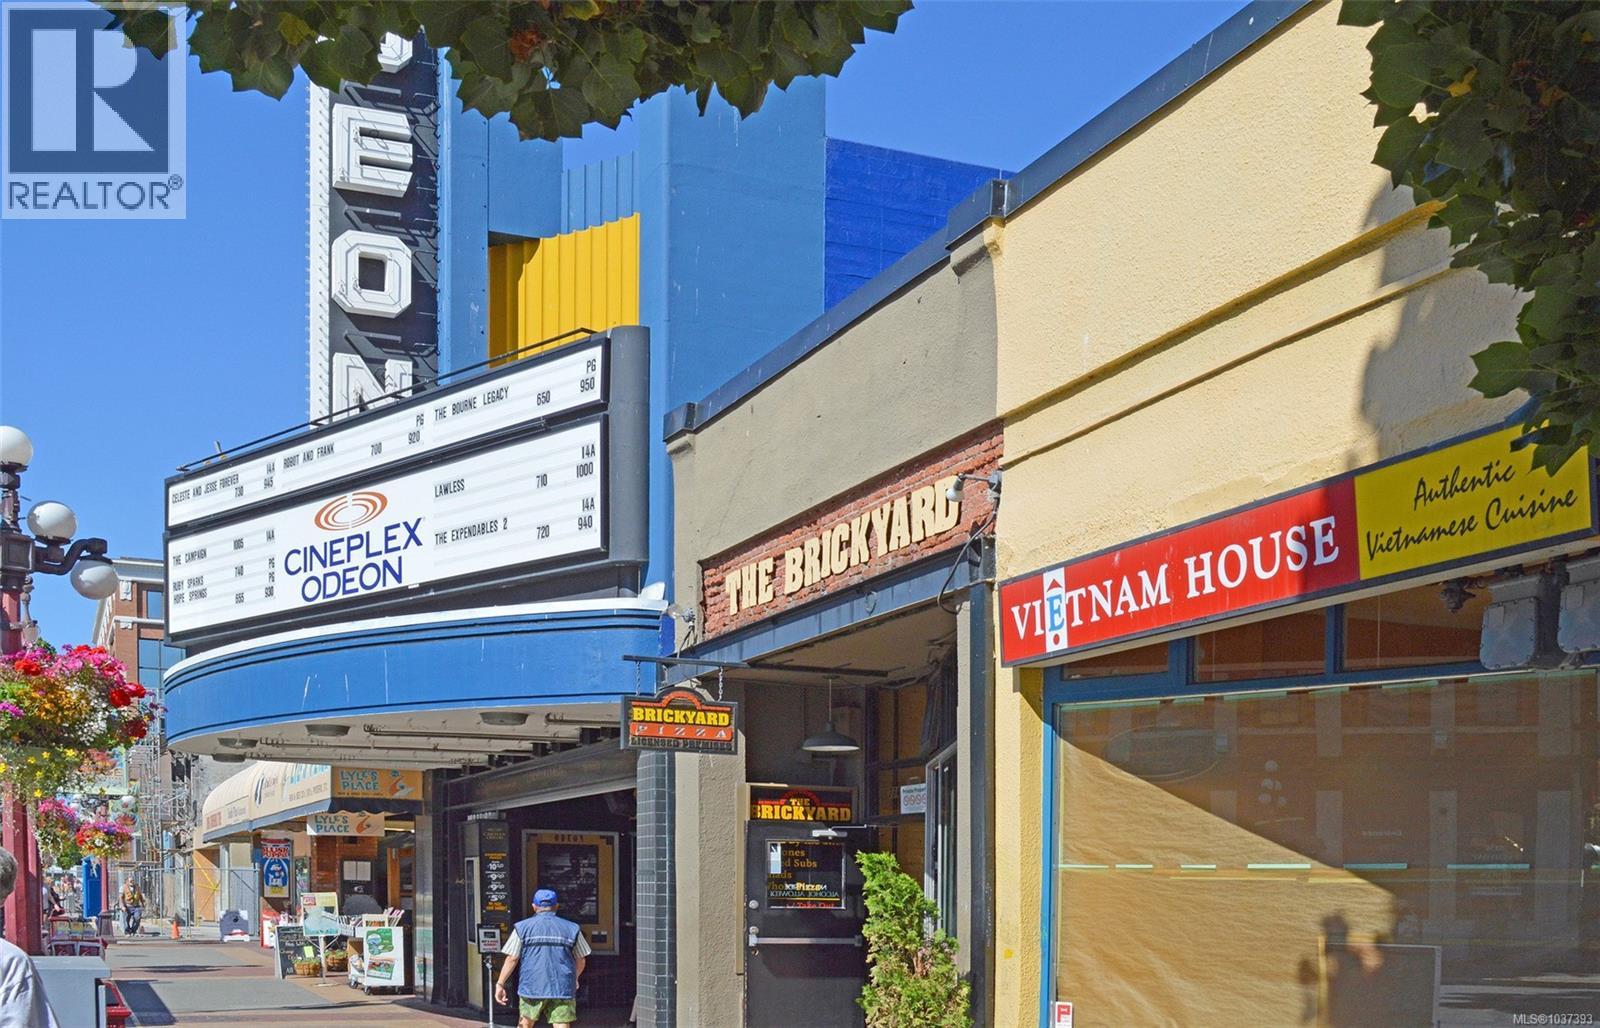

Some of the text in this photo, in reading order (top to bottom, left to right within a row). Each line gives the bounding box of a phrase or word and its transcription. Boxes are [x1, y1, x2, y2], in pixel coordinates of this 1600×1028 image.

[434, 358, 597, 421] THE BOURNE LEGACY PG
[536, 377, 595, 406] 650 950
[283, 413, 425, 469] ROBOT AND FRANK PG
[371, 430, 421, 457] 700 920
[434, 443, 596, 498] LAWLESS 14A
[536, 461, 594, 489] 710 1000
[172, 489, 190, 504] CELESTE
[192, 486, 202, 497] AND
[204, 480, 218, 495] JESSE
[219, 473, 239, 488] FOREVER
[1414, 459, 1516, 511] Authentic
[434, 497, 595, 545] THE EXPENDABLES 2 14A
[536, 515, 593, 540] 720 940
[1366, 489, 1578, 561] Vietnamese Cuisine
[173, 554, 182, 567] THE
[184, 547, 207, 564] CAMPAIGN
[284, 517, 423, 576] CINEPLEX
[725, 475, 962, 616] THE BRICKYARD
[1184, 515, 1340, 600] HOUSE
[187, 575, 204, 589] SPARKS
[301, 556, 403, 602] ODEON
[188, 587, 207, 602] SPRINGS
[632, 707, 730, 726] BRICKYARD
[630, 737, 680, 748] LICENSED
[635, 724, 727, 738] PIZZA
[342, 781, 379, 791] PLACE
[752, 804, 851, 822] BRICKYARD
[789, 798, 810, 806] THE
[316, 824, 350, 833] PLACE
[793, 859, 817, 868] Subs
